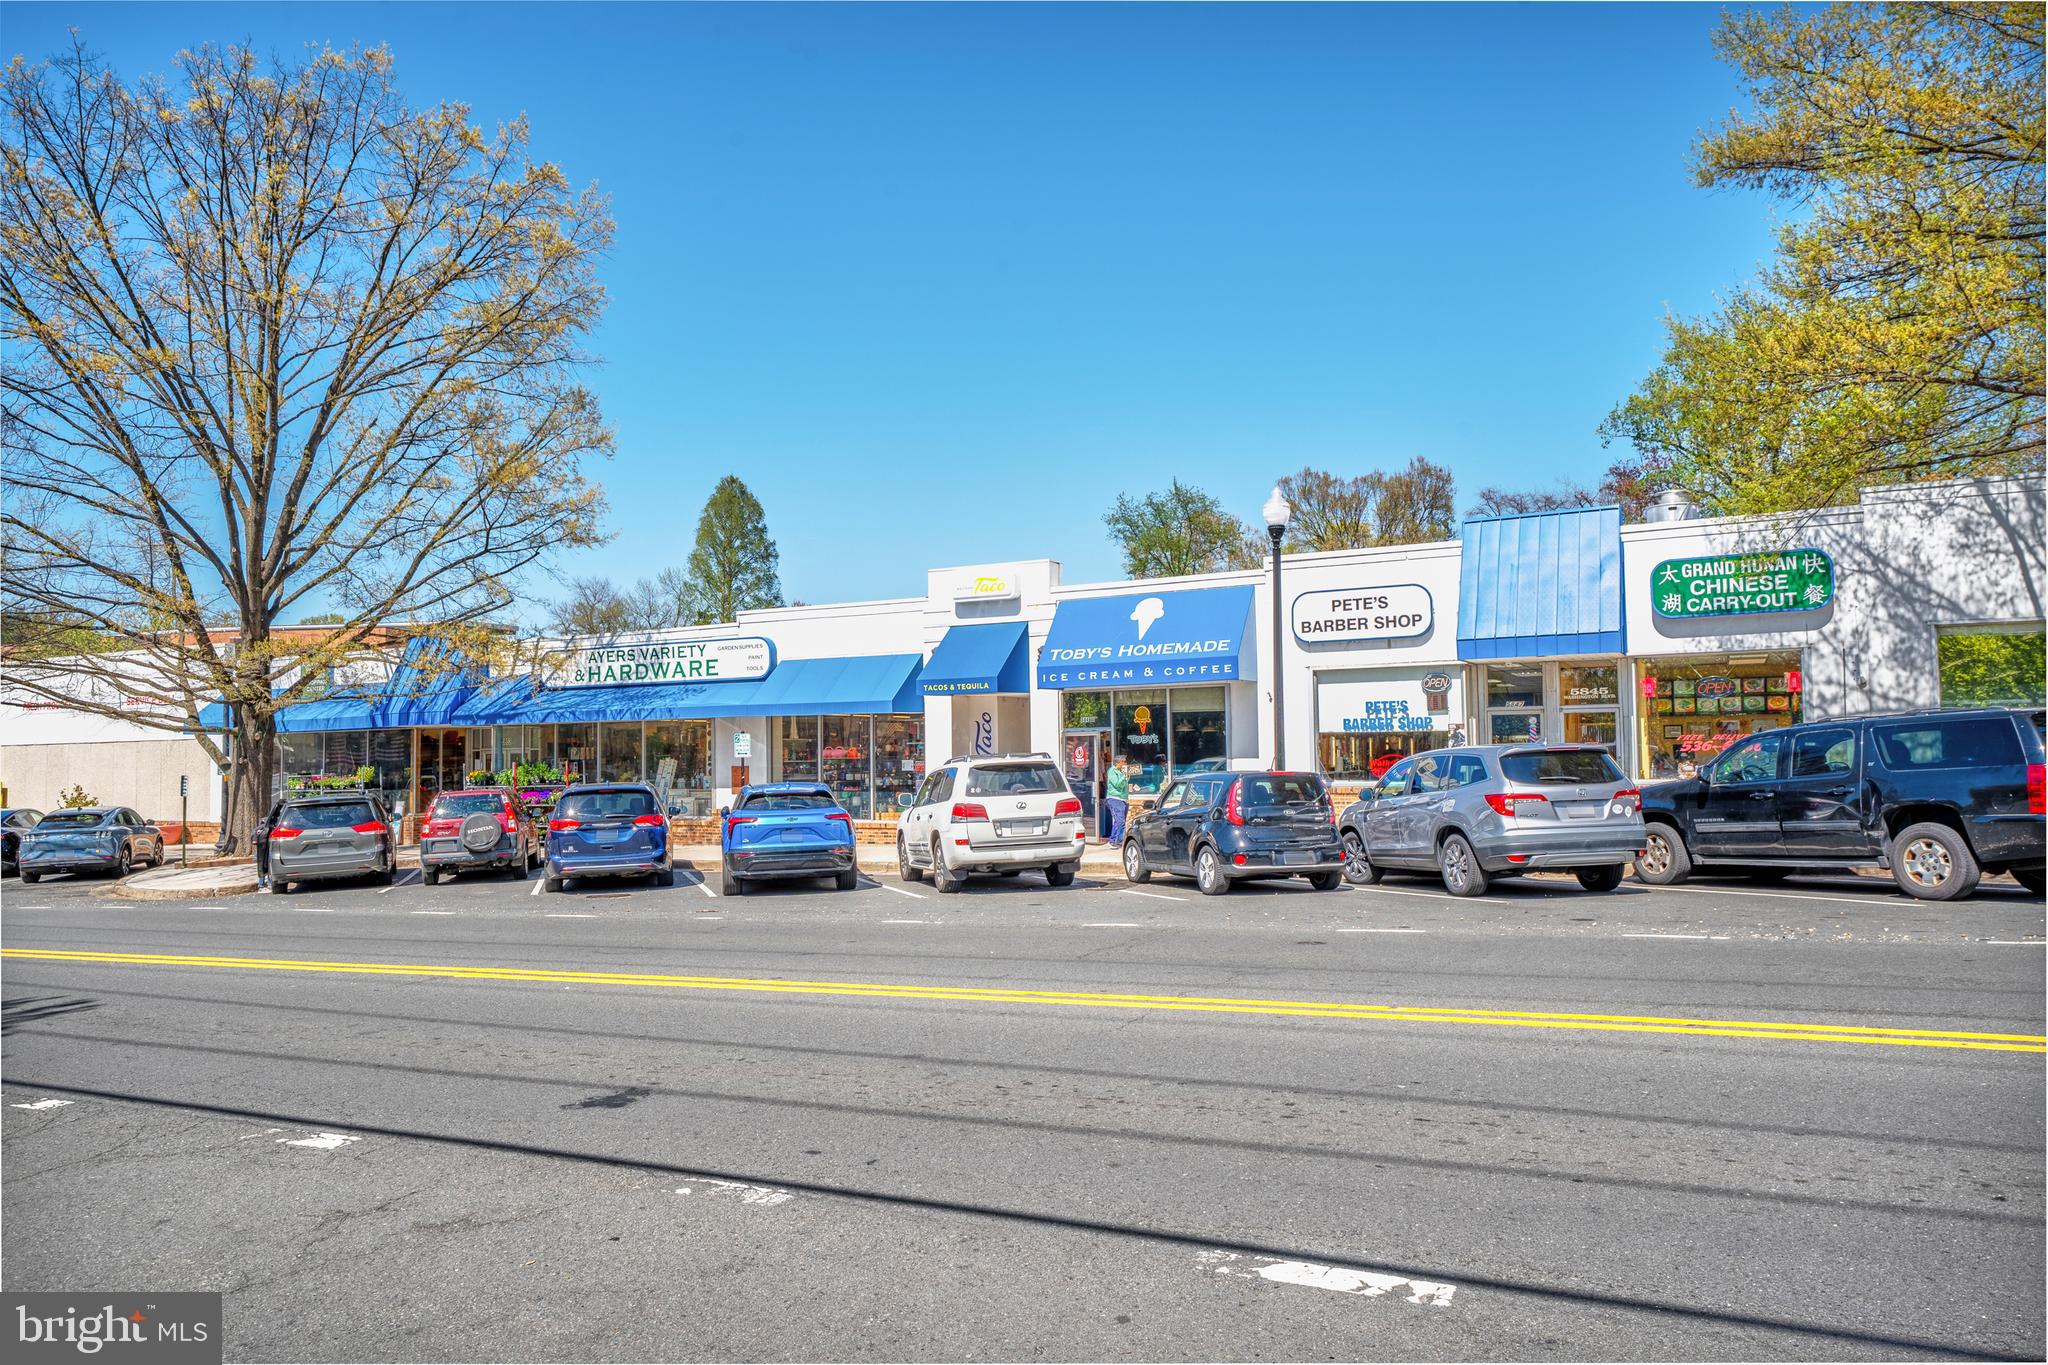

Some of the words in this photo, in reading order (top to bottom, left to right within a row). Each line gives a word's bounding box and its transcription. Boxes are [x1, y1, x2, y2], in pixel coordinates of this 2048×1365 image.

[1681, 562, 1736, 578] GRAND
[1740, 556, 1797, 573] HUNAN
[974, 577, 1006, 595] Taco
[1689, 574, 1789, 596] CHINESE
[1331, 596, 1389, 612] PETE'S
[1686, 592, 1798, 613] CARRY-OUT
[1301, 617, 1369, 634] BARBER
[1374, 614, 1423, 629] SHOP
[588, 649, 636, 664] AYERS
[640, 644, 707, 660] VARIETY
[1050, 647, 1113, 661] TOBY'S
[1117, 639, 1231, 658] HOMEMADE
[575, 669, 585, 682] &
[587, 659, 719, 683] HARDWARE
[1042, 673, 1069, 683] ICE
[1078, 669, 1134, 681] CREAM
[1143, 667, 1154, 677] &
[1164, 664, 1232, 676] COFFEE
[957, 682, 990, 690] TEQUILA
[1423, 677, 1448, 688] OPEN
[1698, 681, 1733, 695] OPEN
[1570, 687, 1609, 697] 5845
[1365, 700, 1409, 714] PETE'S
[1343, 717, 1394, 731] BARBER
[1398, 716, 1433, 731] SHOP
[467, 825, 494, 834] HONDA
